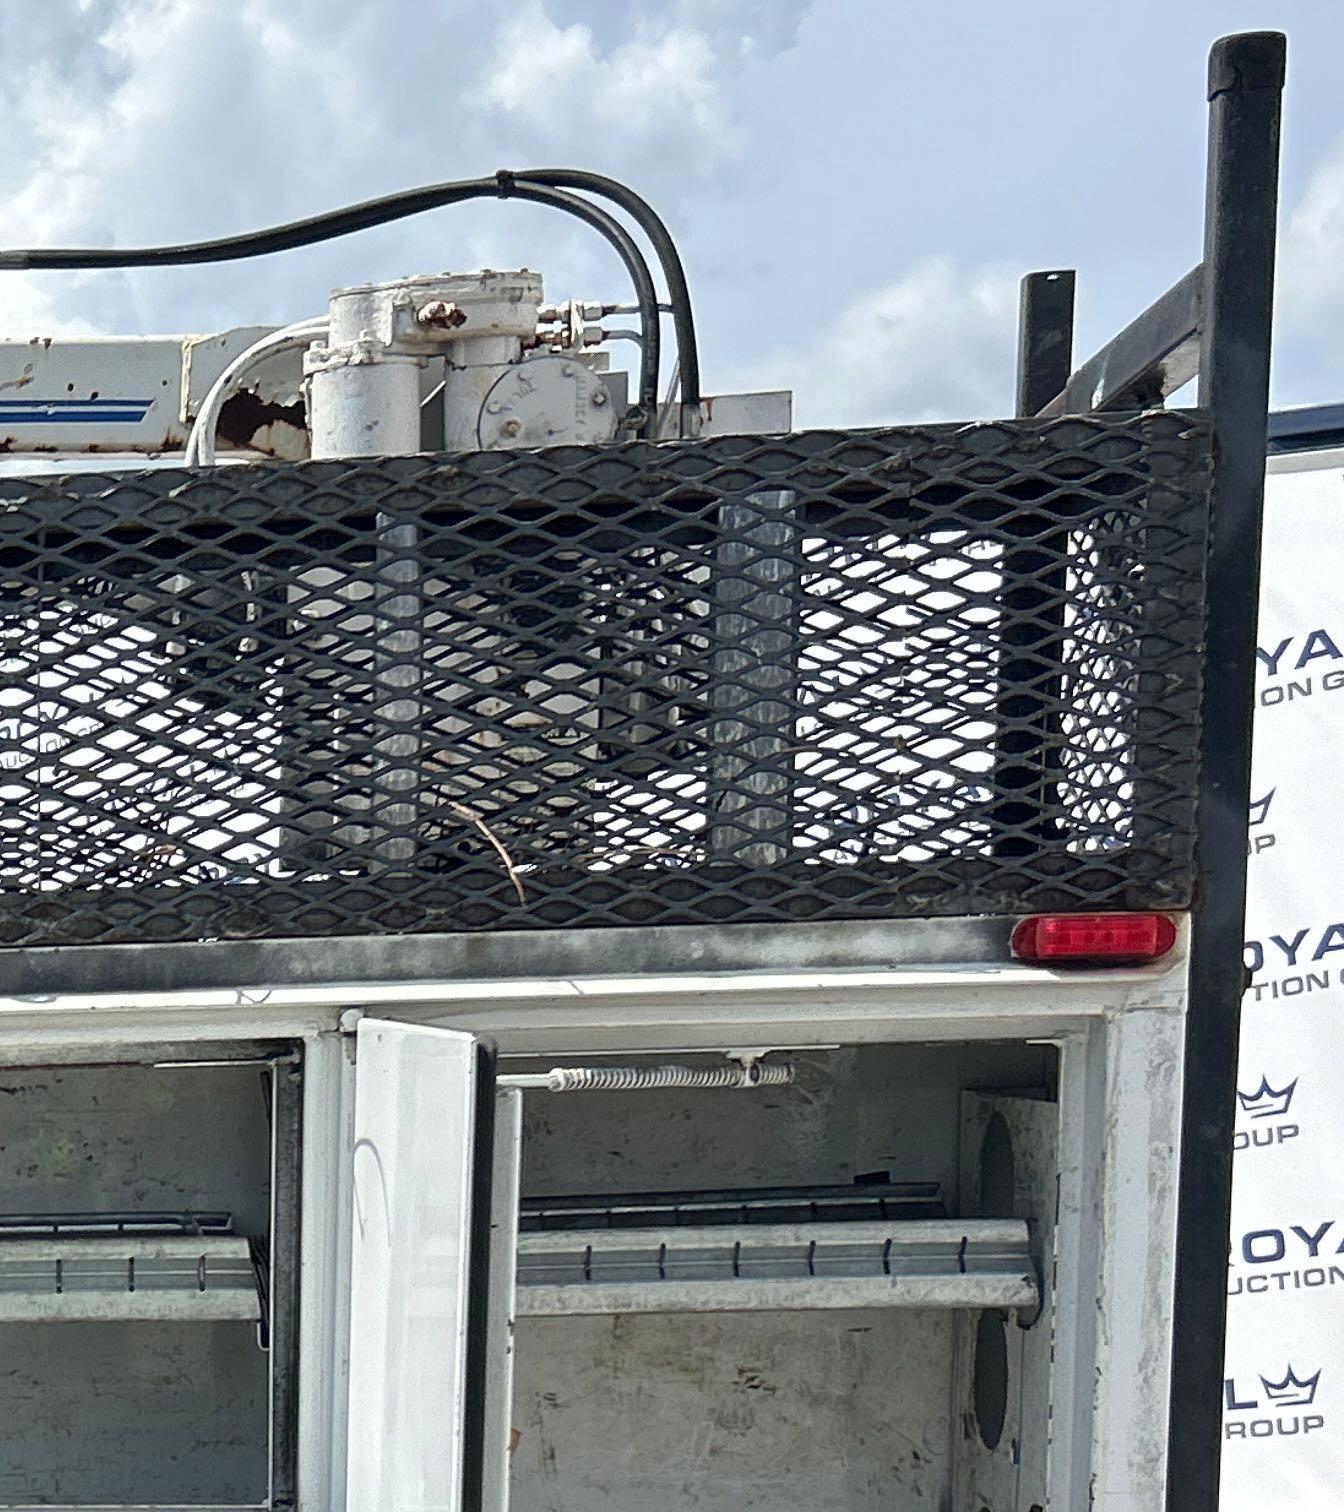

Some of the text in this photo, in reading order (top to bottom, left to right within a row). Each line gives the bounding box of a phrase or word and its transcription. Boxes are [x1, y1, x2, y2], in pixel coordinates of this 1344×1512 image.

[1248, 833, 1276, 856] P
[1230, 1220, 1344, 1267] OY
[1225, 1378, 1258, 1410] L
[1225, 1415, 1324, 1439] ROUP
